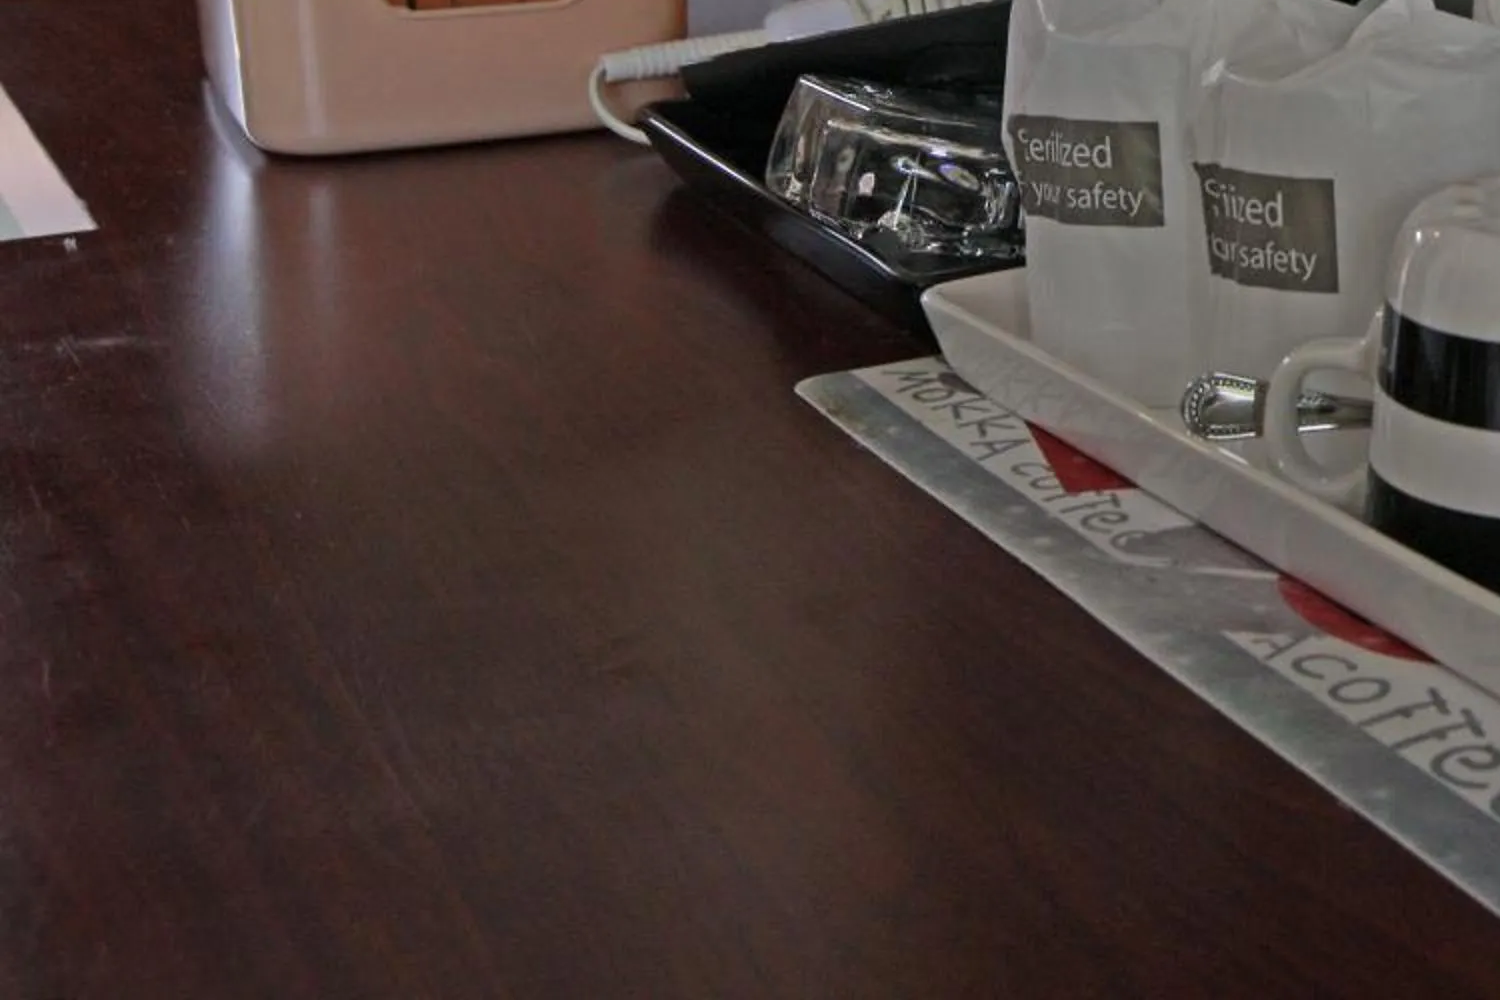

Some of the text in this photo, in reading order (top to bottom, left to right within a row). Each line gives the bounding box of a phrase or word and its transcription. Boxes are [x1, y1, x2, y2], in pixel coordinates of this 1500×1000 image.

[1066, 181, 1143, 217] safety
[1239, 239, 1318, 282] safety
[882, 369, 1031, 461] MOKKA
